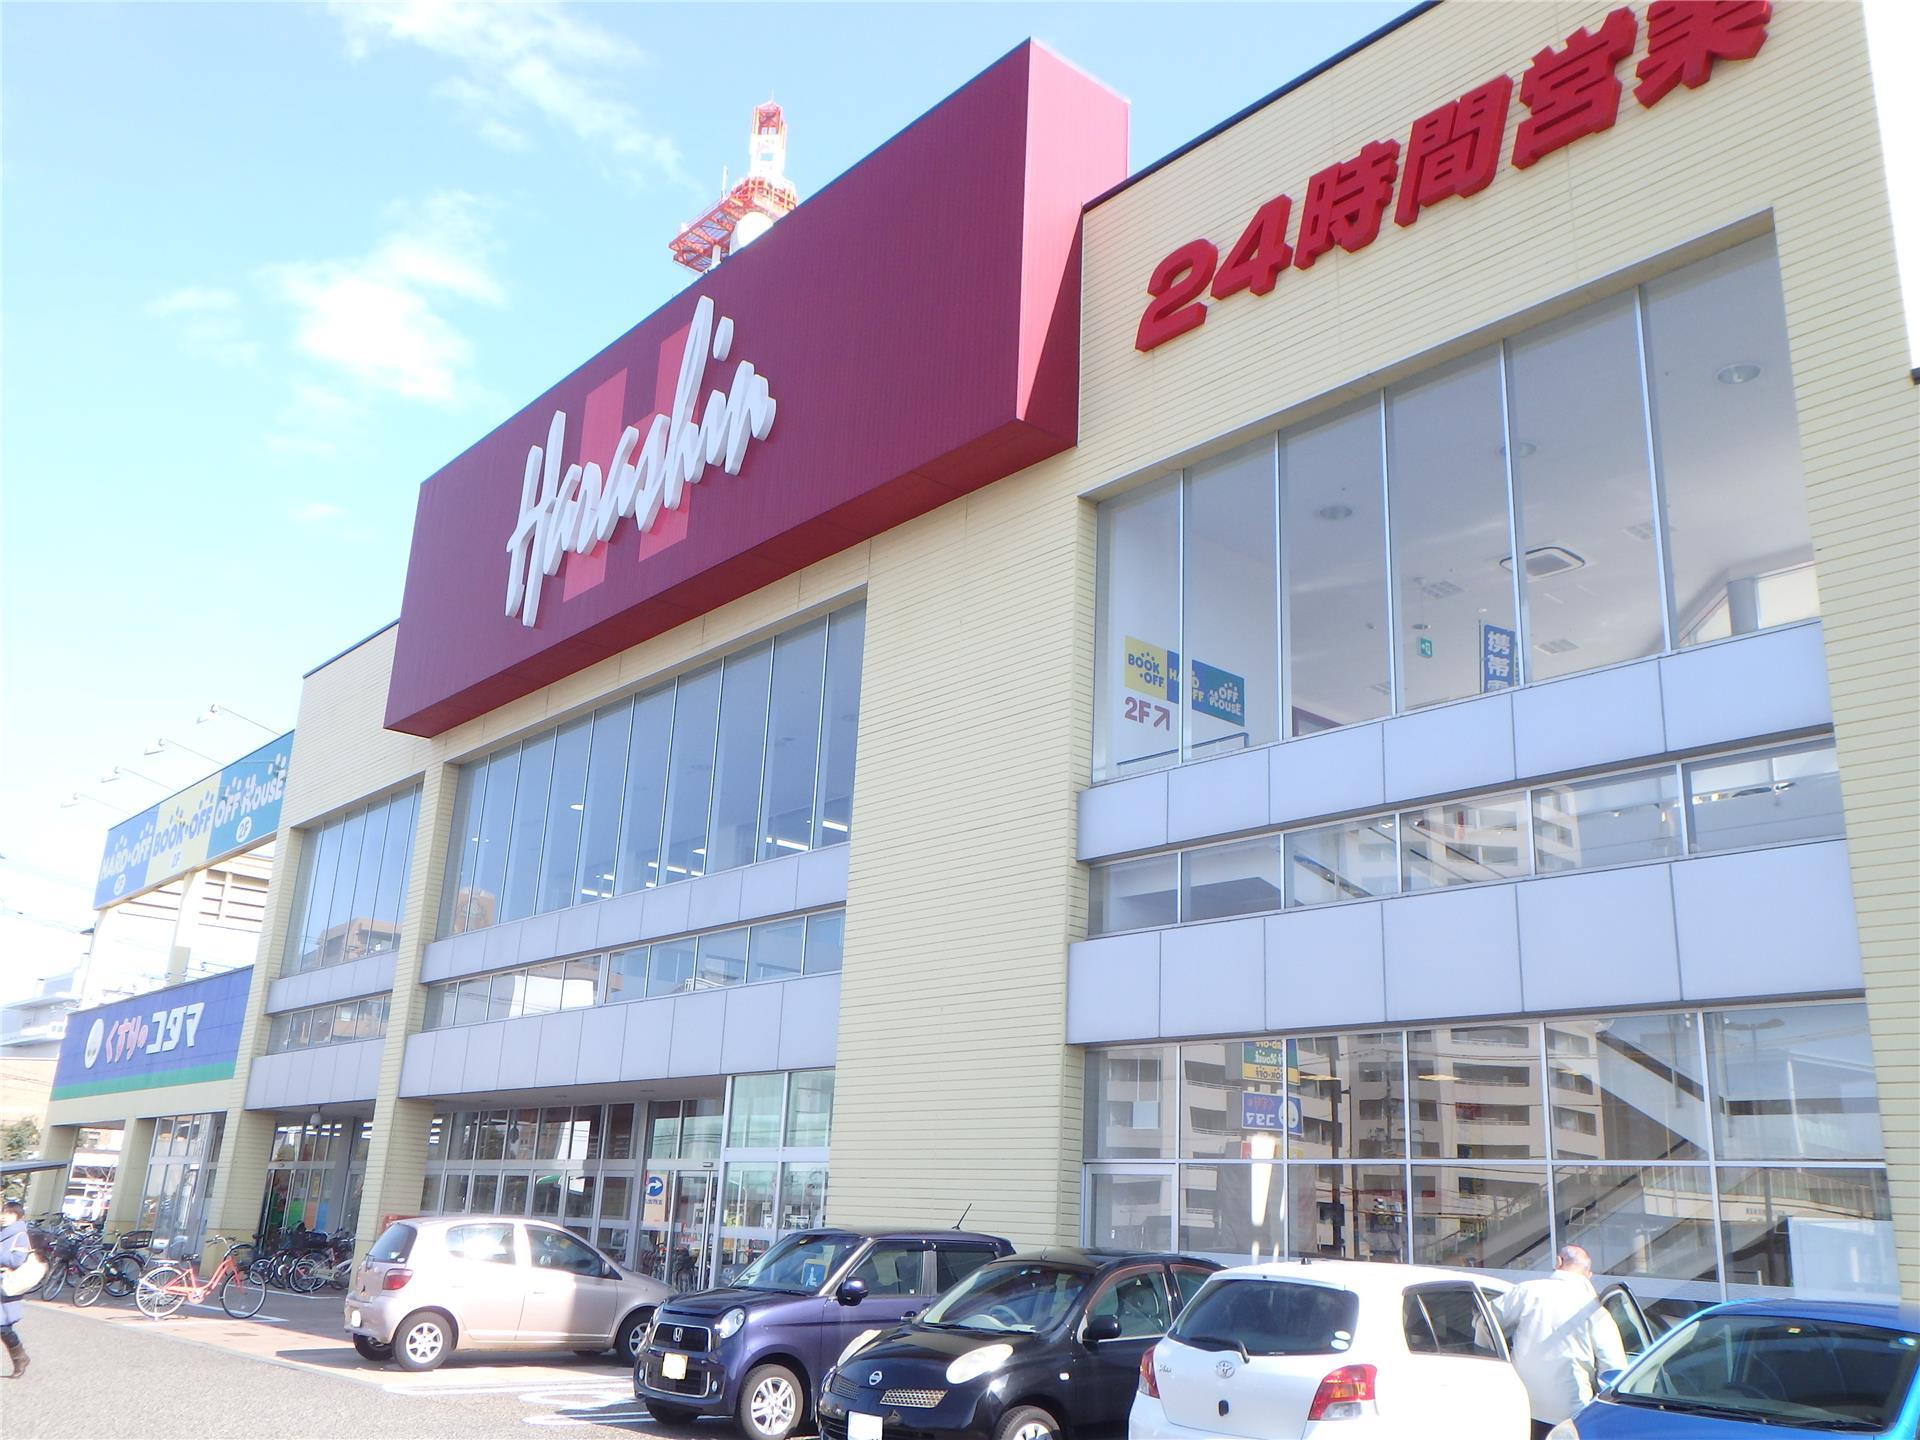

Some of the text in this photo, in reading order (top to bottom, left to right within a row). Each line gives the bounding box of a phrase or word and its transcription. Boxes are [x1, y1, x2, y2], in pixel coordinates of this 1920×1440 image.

[1135, 0, 1772, 353] 24時間営業
[505, 295, 776, 627] Harashin
[1128, 653, 1160, 674] BOOK
[1209, 690, 1242, 716] HOUSE
[1219, 686, 1239, 702] OFF
[1124, 696, 1151, 723] 2F
[215, 771, 286, 828] OFF HOUSE
